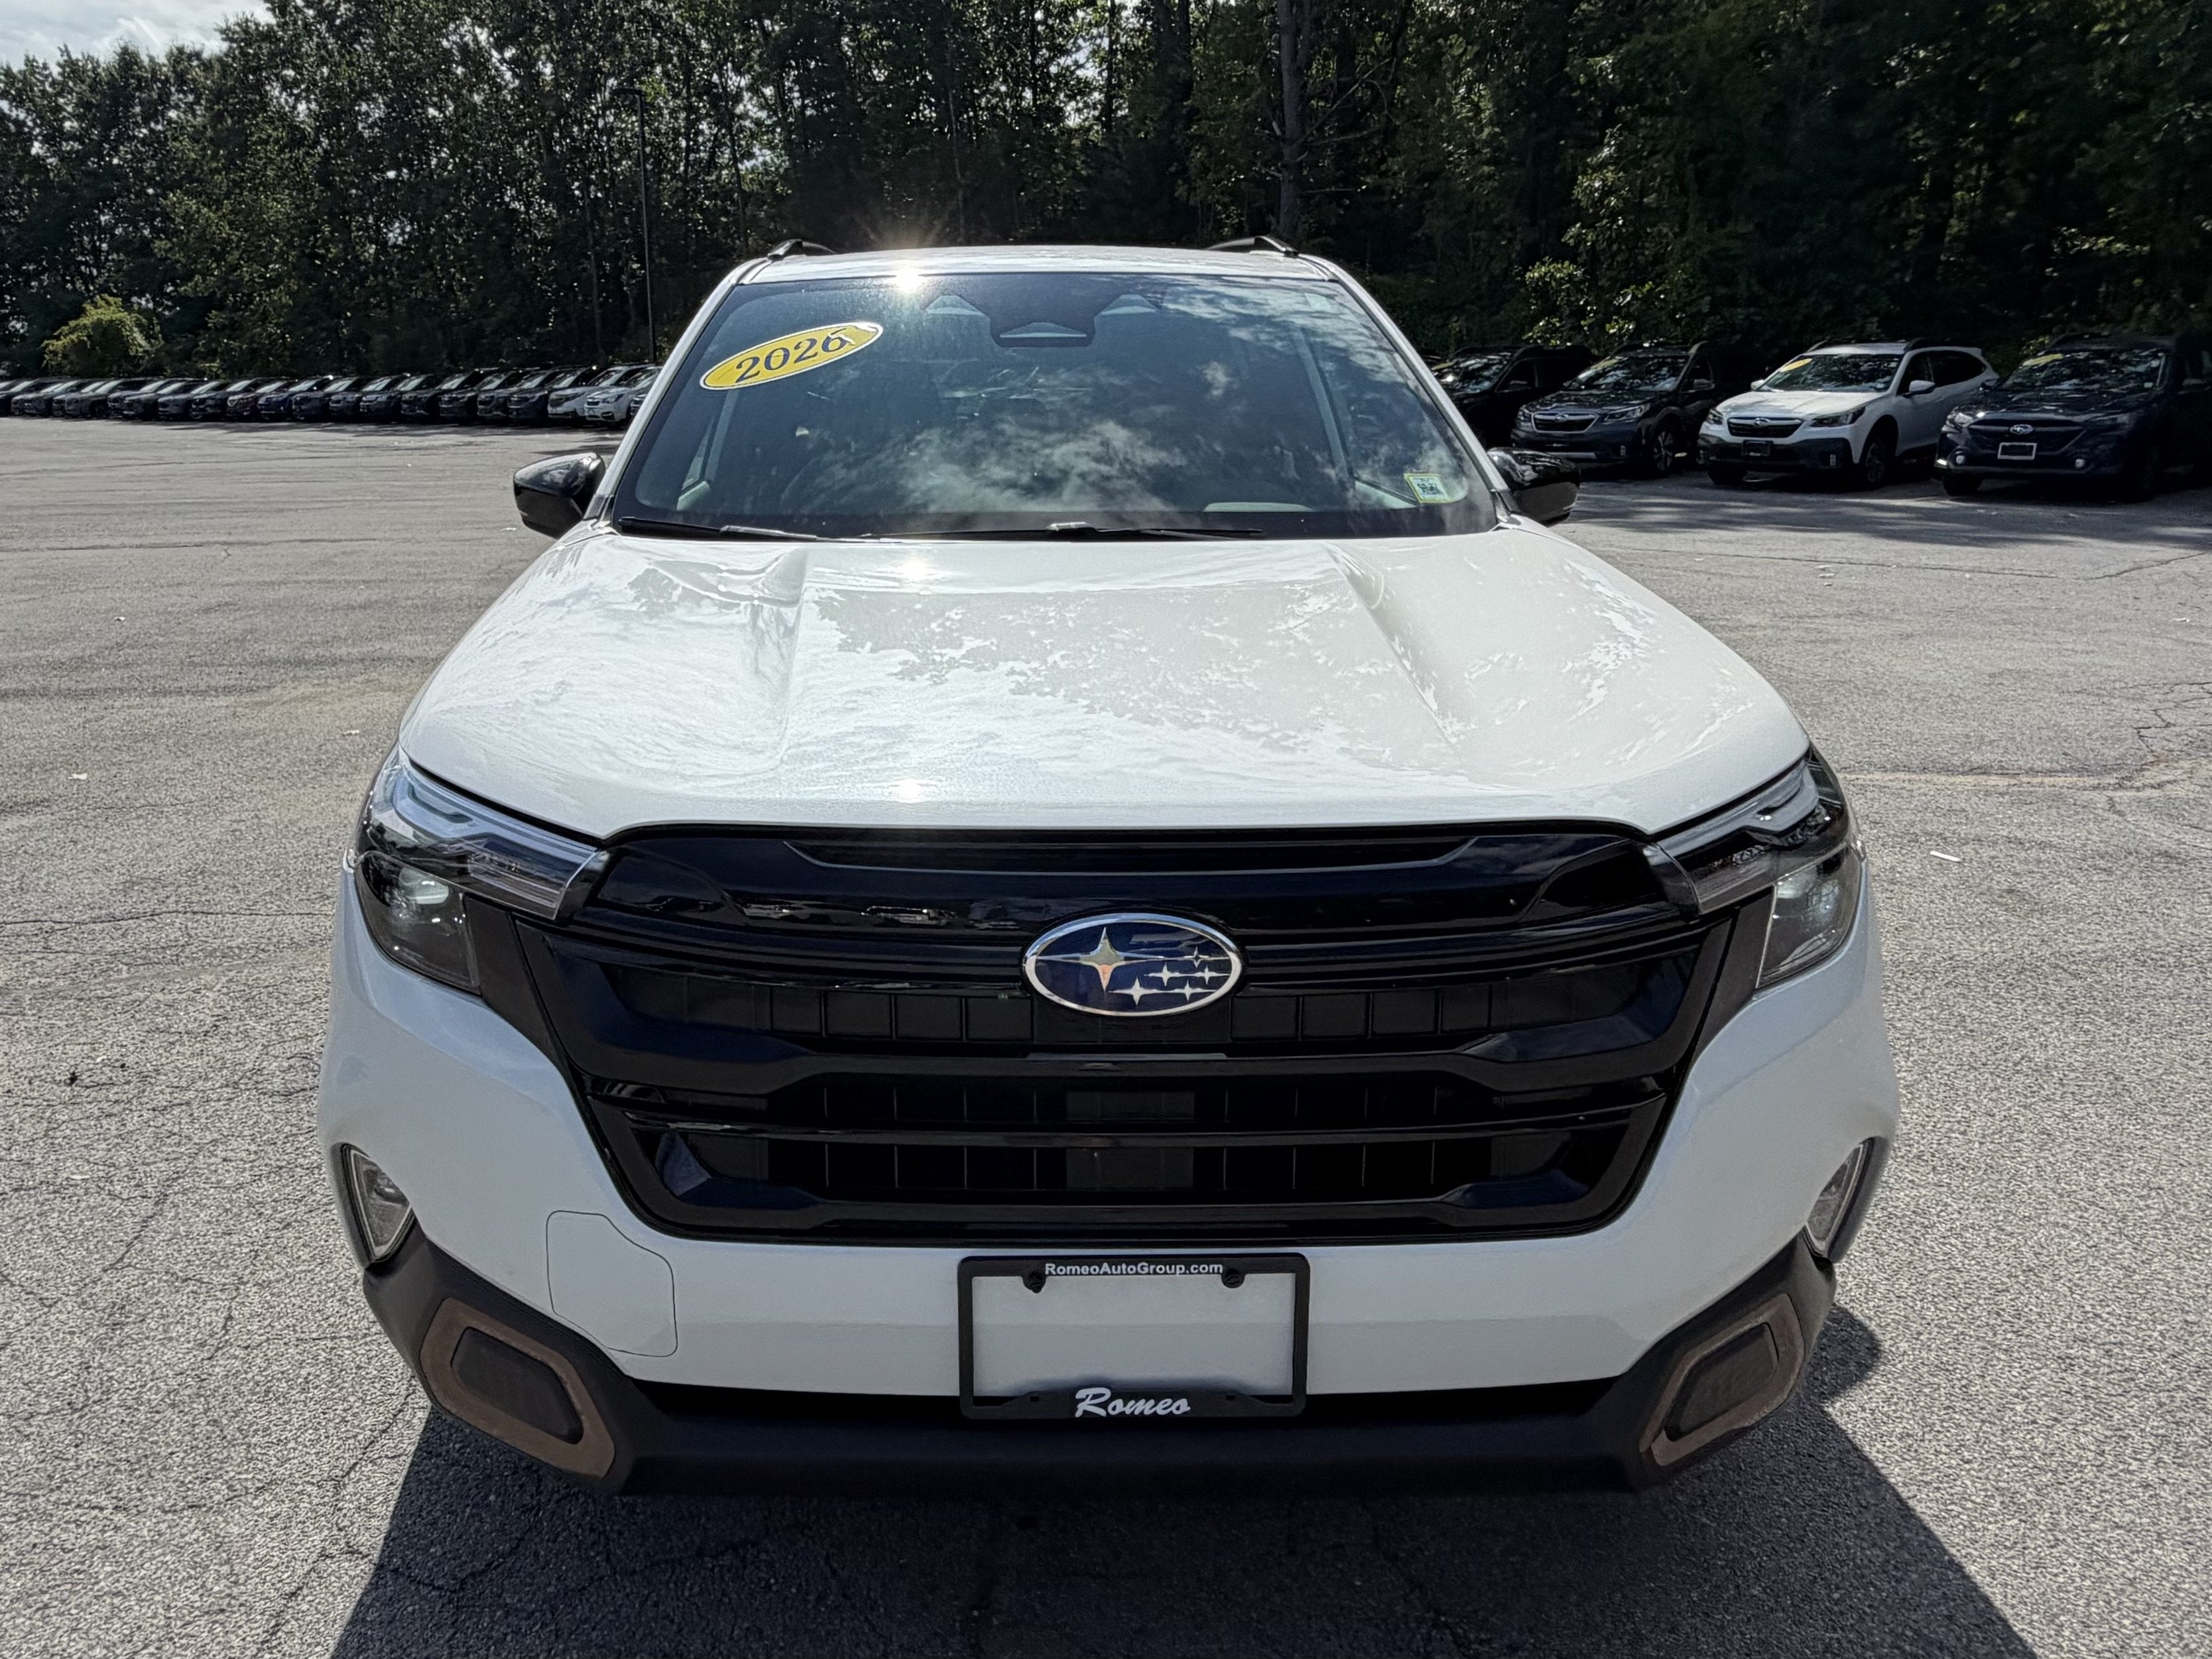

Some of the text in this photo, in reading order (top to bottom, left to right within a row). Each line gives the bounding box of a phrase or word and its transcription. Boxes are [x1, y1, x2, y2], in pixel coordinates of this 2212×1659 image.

[736, 328, 853, 383] 2026
[1045, 1262, 1223, 1275] RomeoAutoGroup.com
[1075, 1388, 1191, 1418] Romeo
